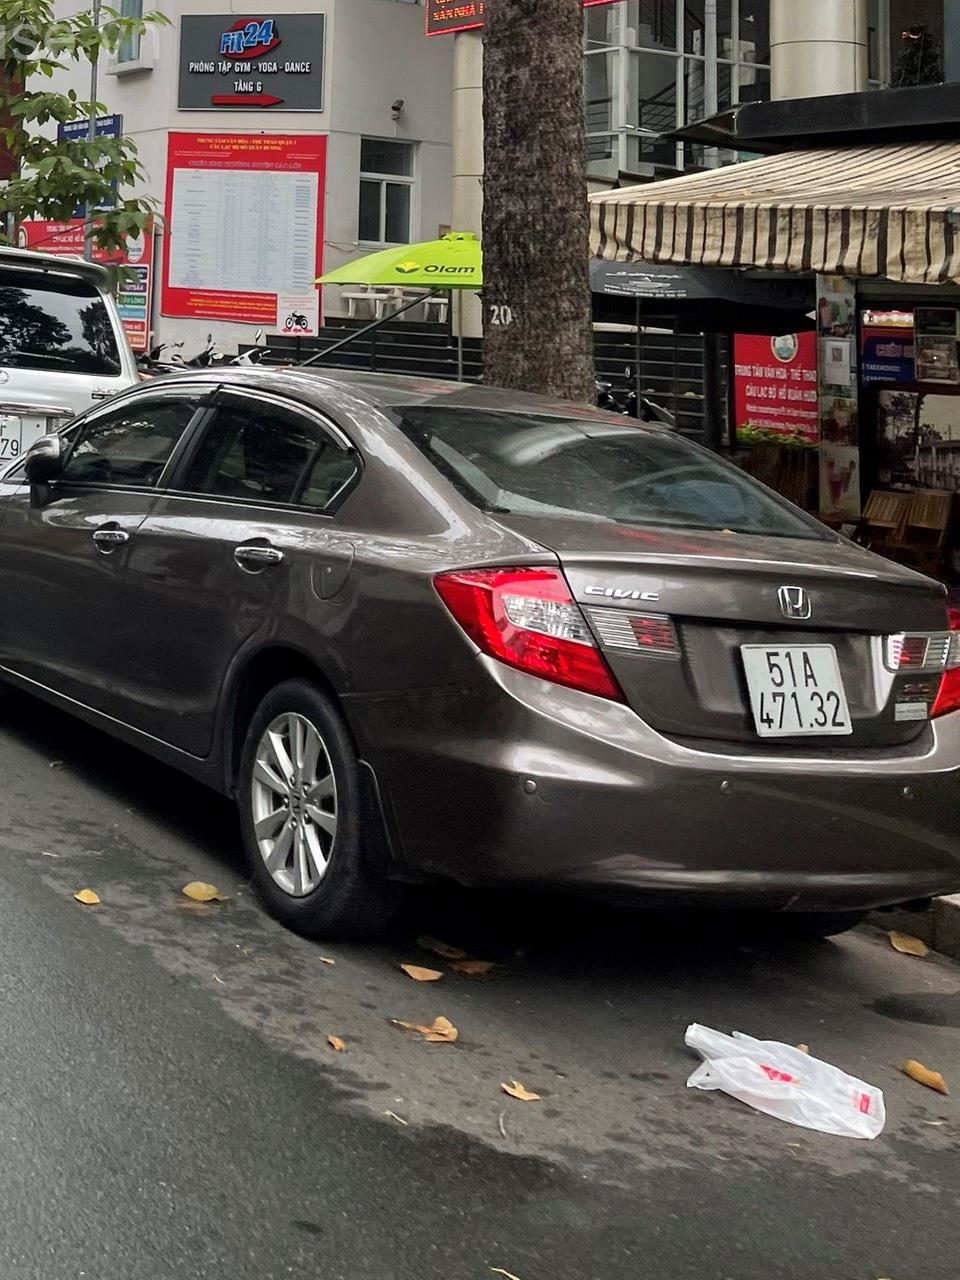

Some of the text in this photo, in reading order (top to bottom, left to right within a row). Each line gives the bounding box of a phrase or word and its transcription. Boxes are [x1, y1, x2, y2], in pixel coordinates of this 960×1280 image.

[220, 19, 275, 54] Fit24
[189, 61, 215, 73] PHÒNG
[218, 61, 232, 75] TẬP
[234, 62, 251, 73] GYM
[258, 62, 278, 73] YOGA
[284, 62, 311, 73] DANCE
[234, 79, 254, 93] TẦNG
[424, 265, 475, 273] Olam
[490, 305, 513, 325] 20
[584, 586, 659, 601] CIVIC
[766, 651, 818, 688] 51A
[759, 691, 845, 730] 471.32
